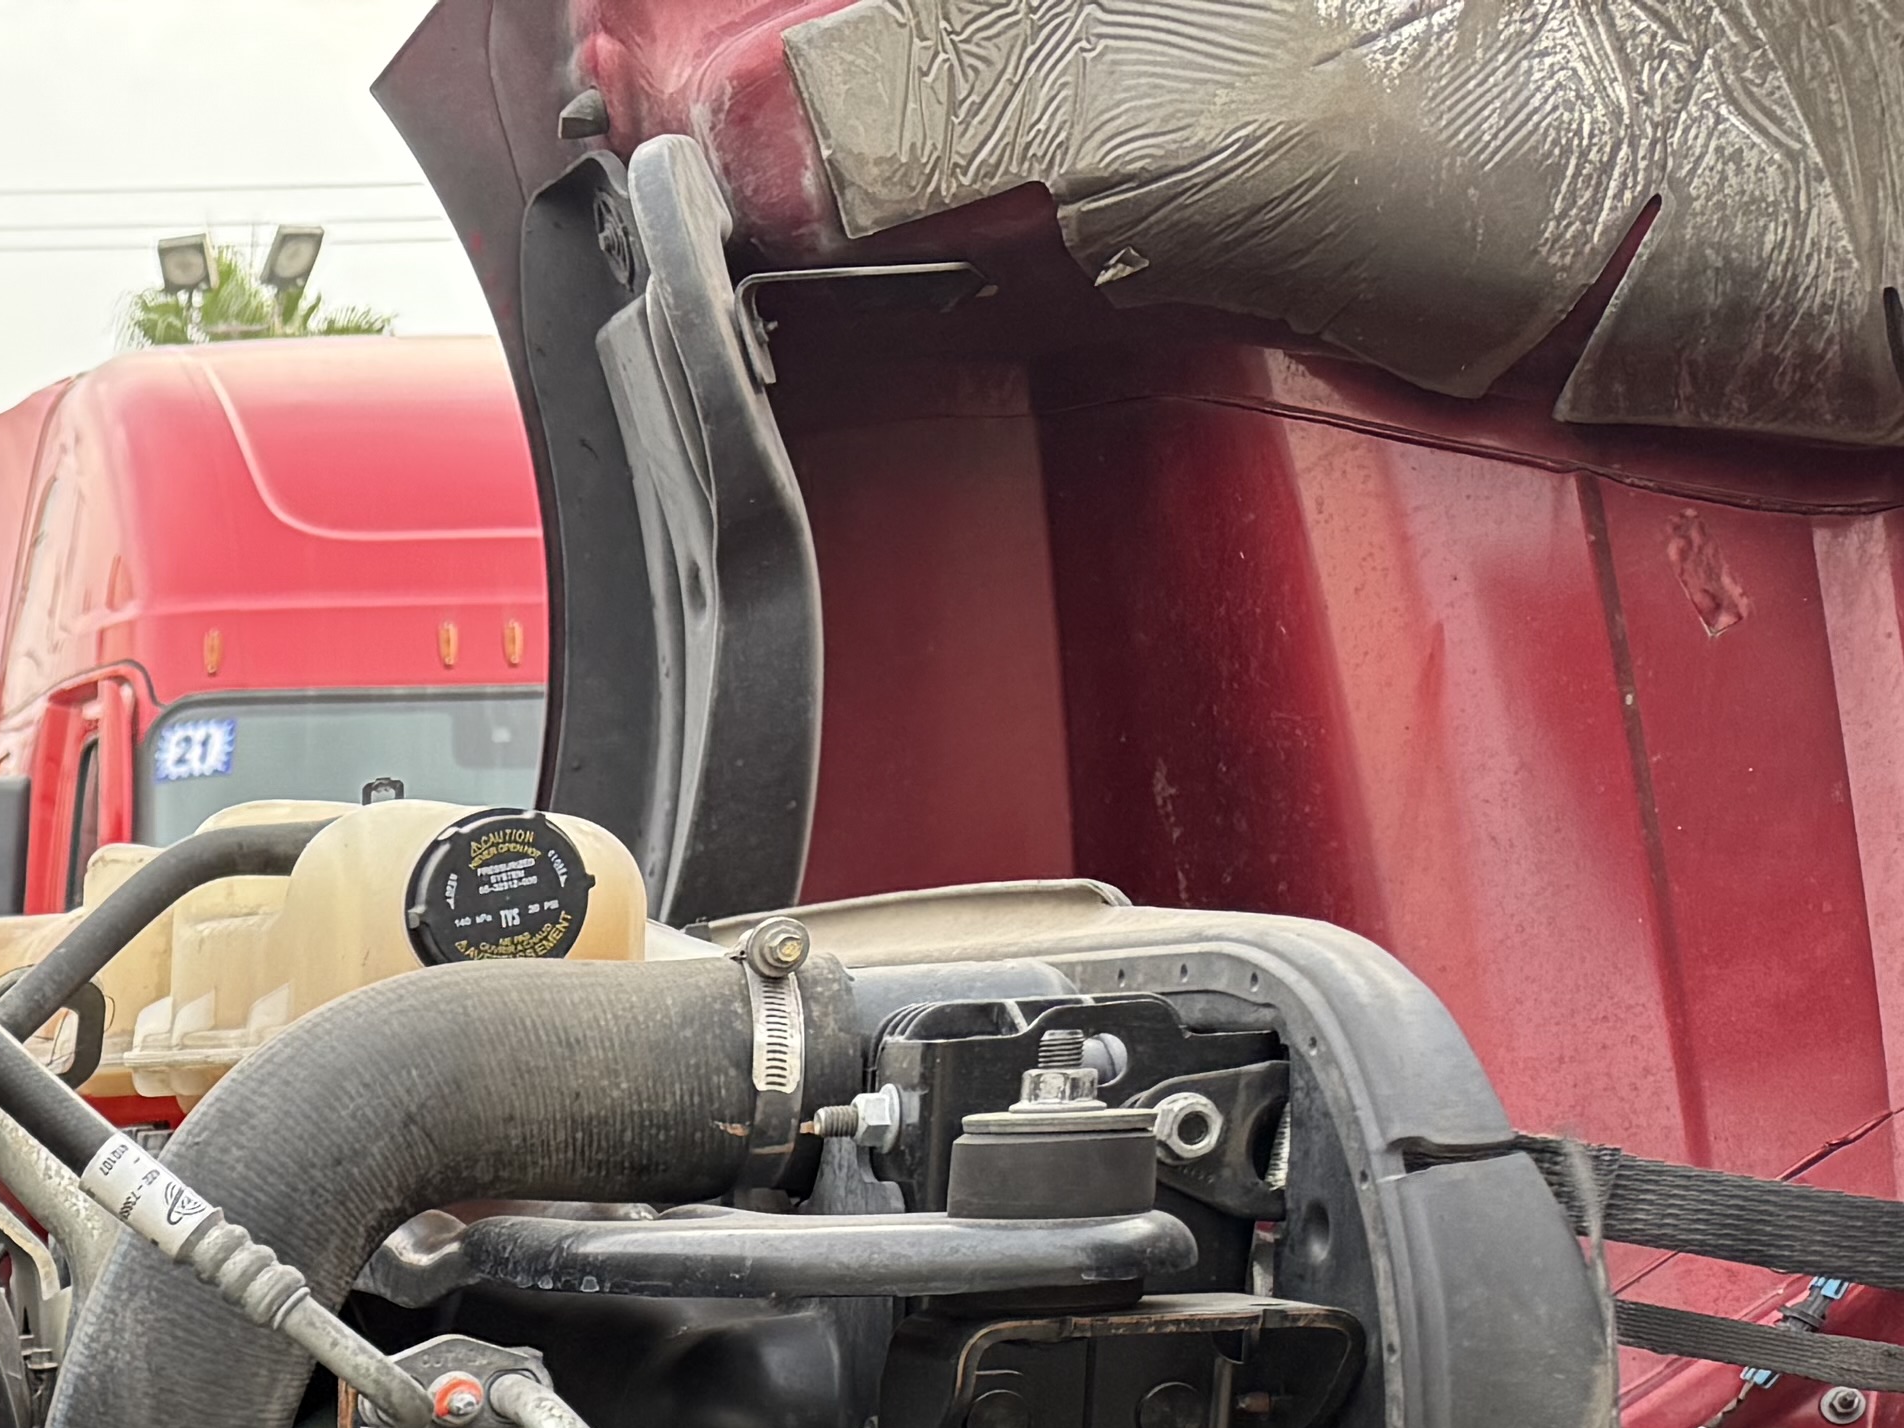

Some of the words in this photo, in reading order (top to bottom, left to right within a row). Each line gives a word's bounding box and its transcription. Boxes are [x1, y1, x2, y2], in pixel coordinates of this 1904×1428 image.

[480, 829, 535, 848] CAUTION
[490, 870, 525, 883] SYSTEM
[499, 908, 521, 928] TVS
